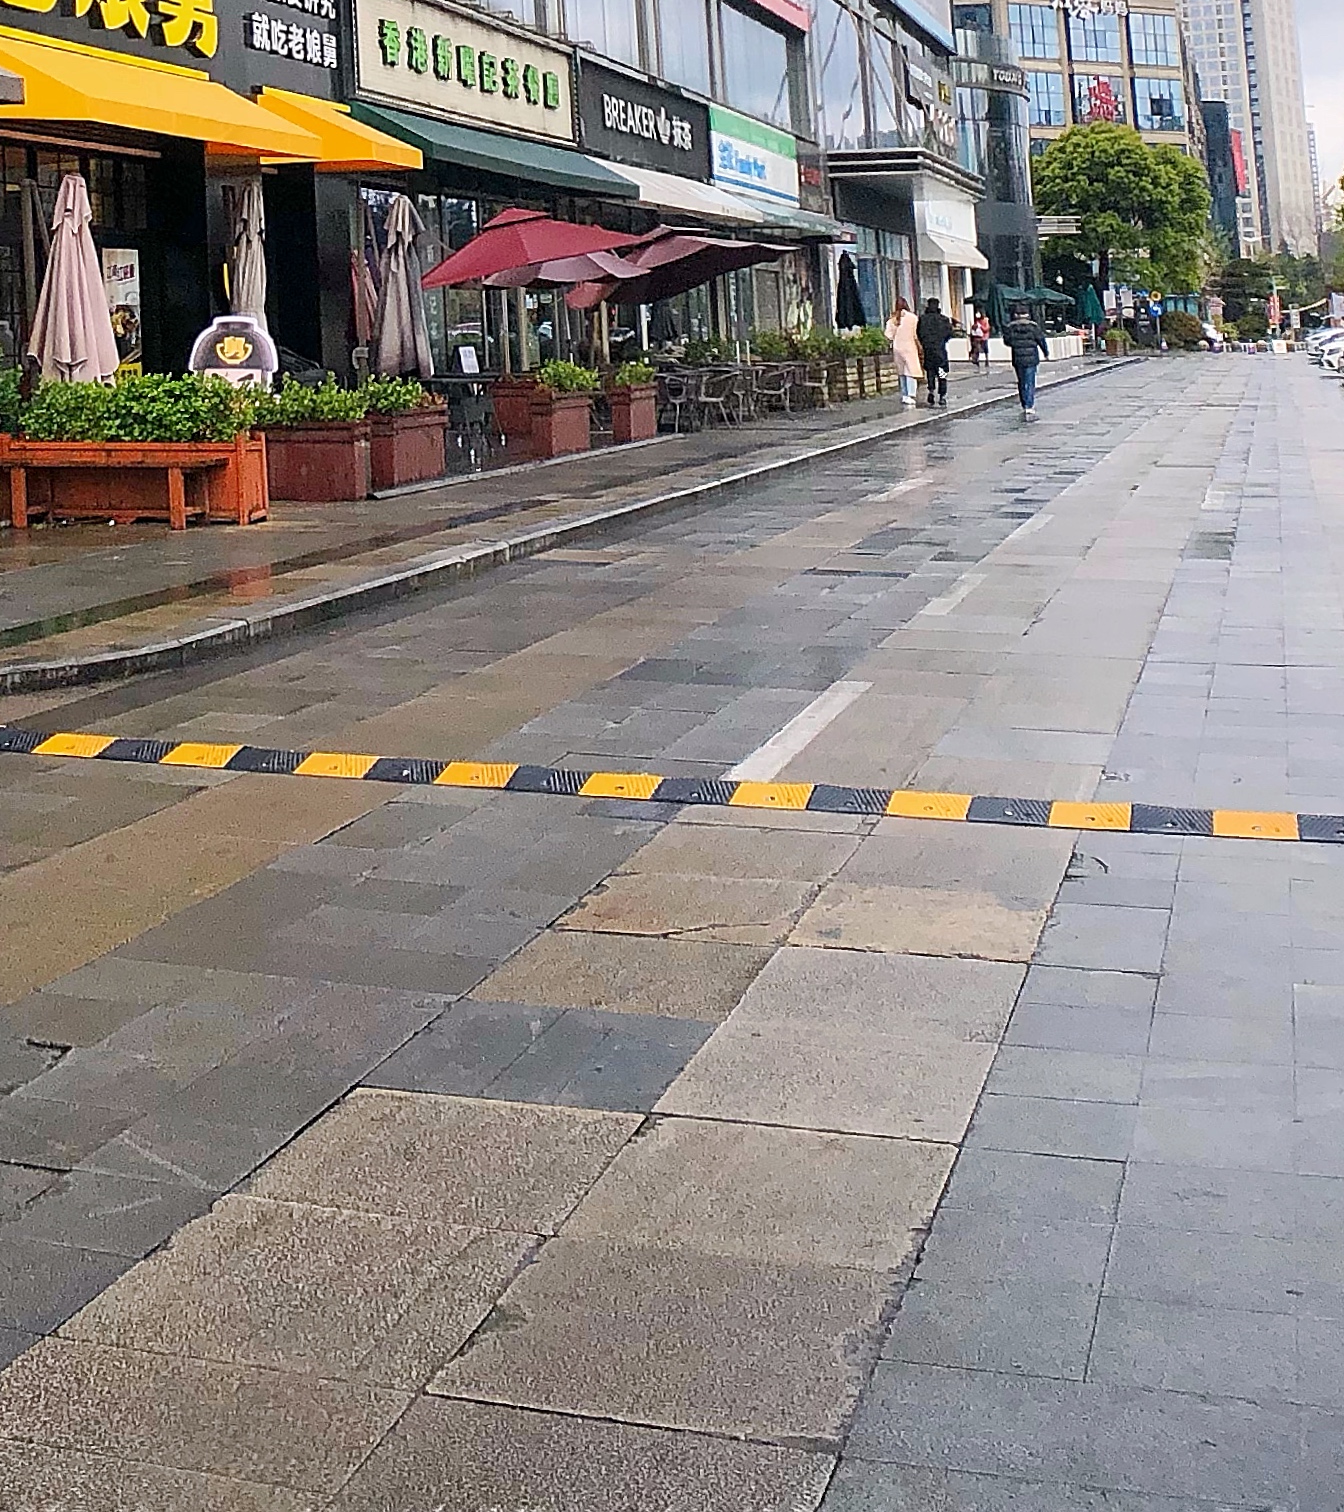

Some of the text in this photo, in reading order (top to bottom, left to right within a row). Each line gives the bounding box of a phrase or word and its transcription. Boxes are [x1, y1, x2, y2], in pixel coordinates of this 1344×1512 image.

[251, 12, 338, 70] 就吃老娘舅
[603, 93, 657, 141] BREAKER
